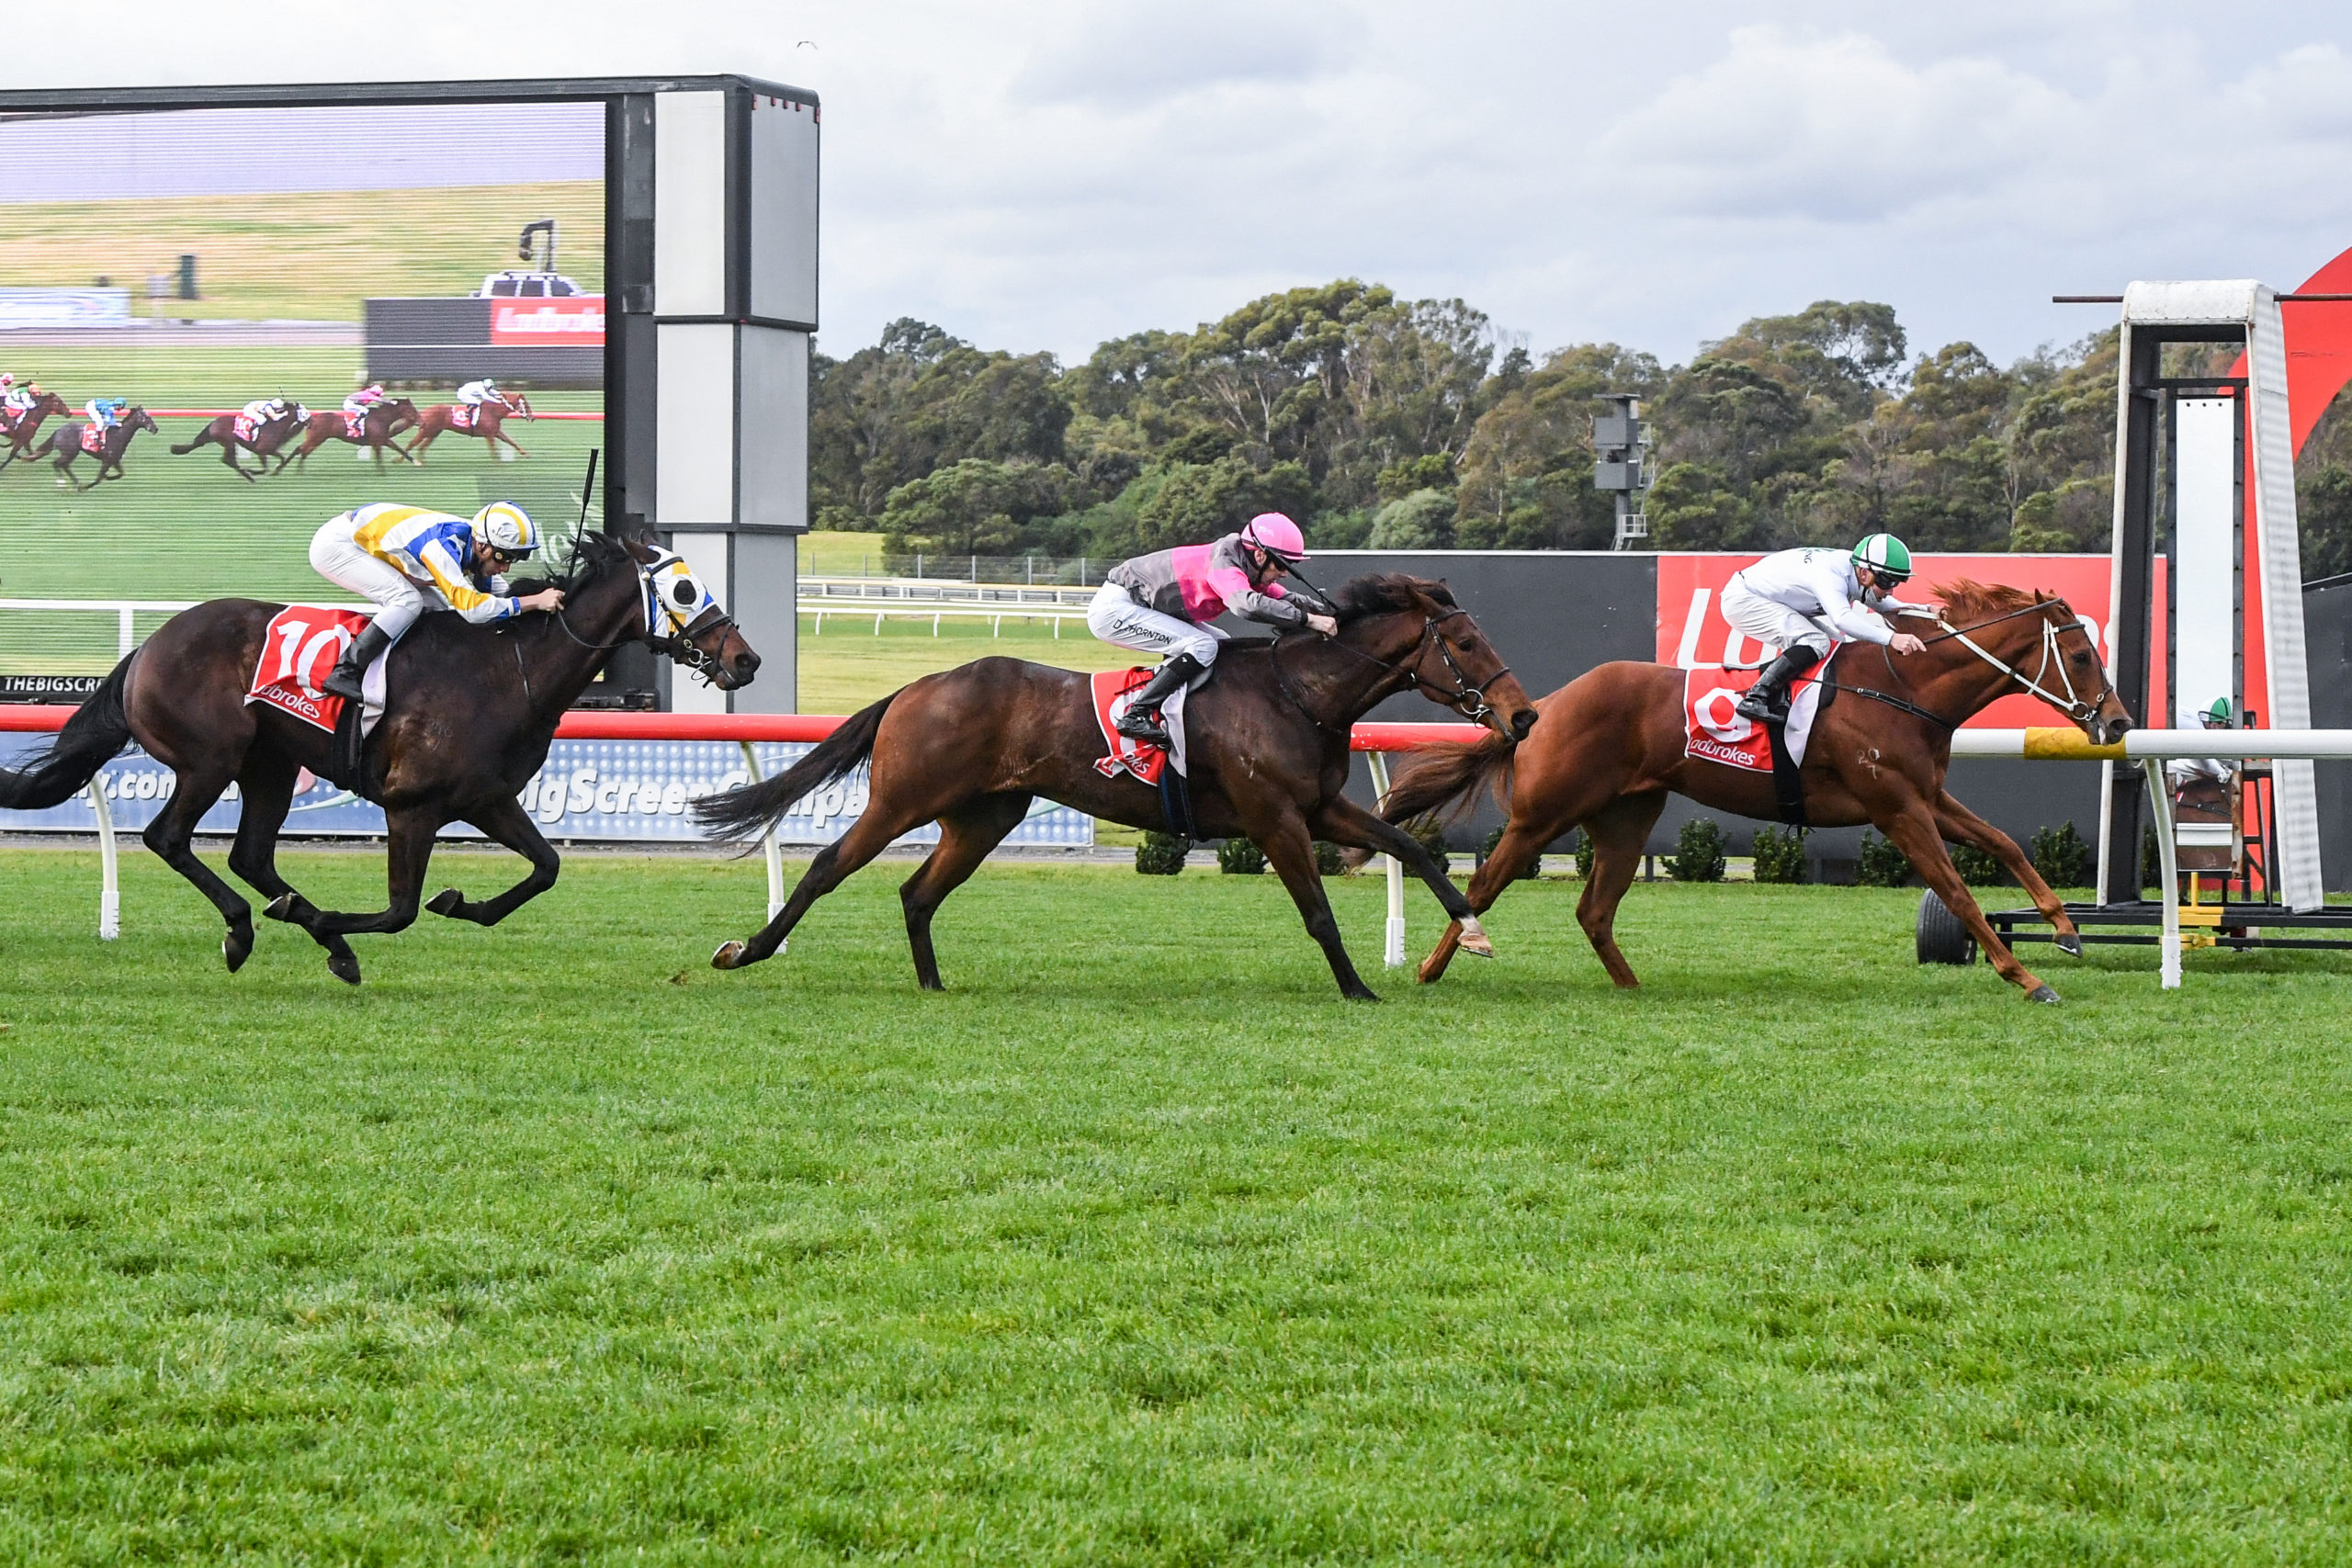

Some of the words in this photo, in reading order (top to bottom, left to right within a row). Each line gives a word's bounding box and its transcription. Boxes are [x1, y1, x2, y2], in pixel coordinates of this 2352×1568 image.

[1113, 619, 1123, 629] D
[277, 620, 351, 701] 10
[1690, 737, 1756, 766] adbrokes
